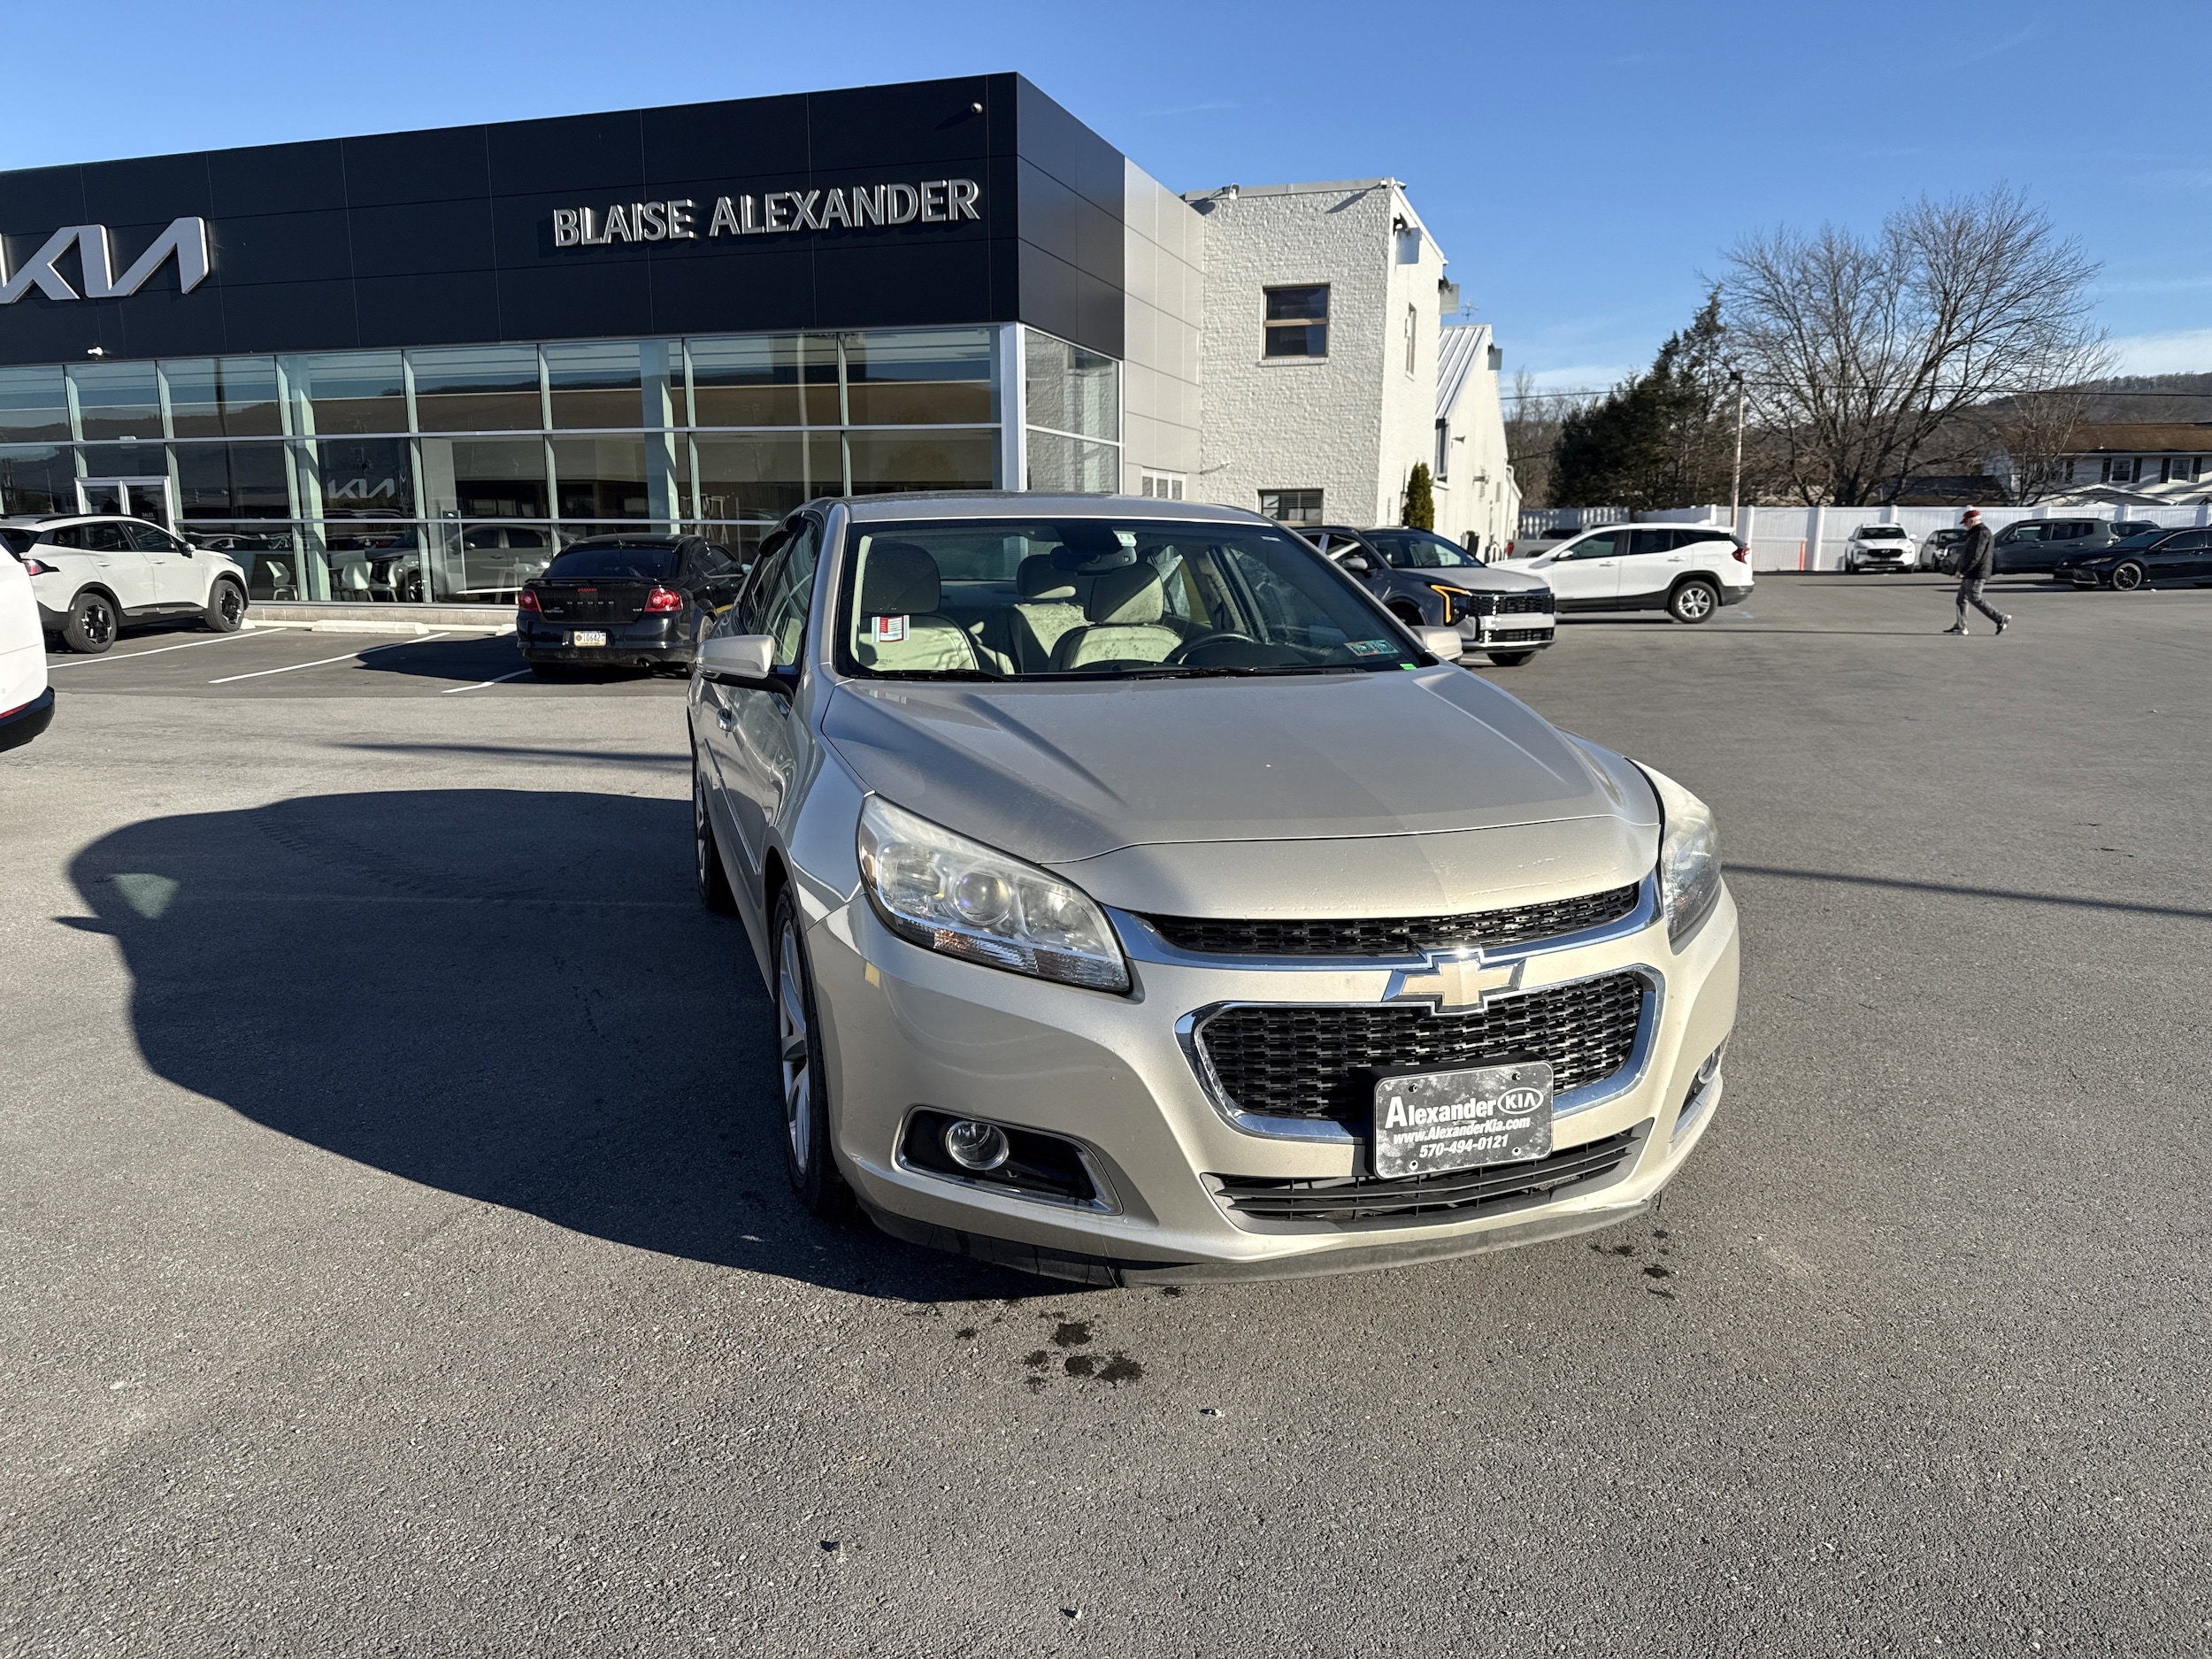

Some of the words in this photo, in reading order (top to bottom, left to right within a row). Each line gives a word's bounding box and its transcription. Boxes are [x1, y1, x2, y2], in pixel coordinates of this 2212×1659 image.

[554, 199, 694, 247] BLAISE
[709, 178, 980, 237] ALEXANDER
[327, 478, 396, 499] KIA
[1385, 1095, 1497, 1129] Alexander
[1503, 1092, 1537, 1110] KIA
[1393, 1117, 1531, 1145] www.AlexanderKia.com
[1418, 1133, 1509, 1158] 570-494-0121
